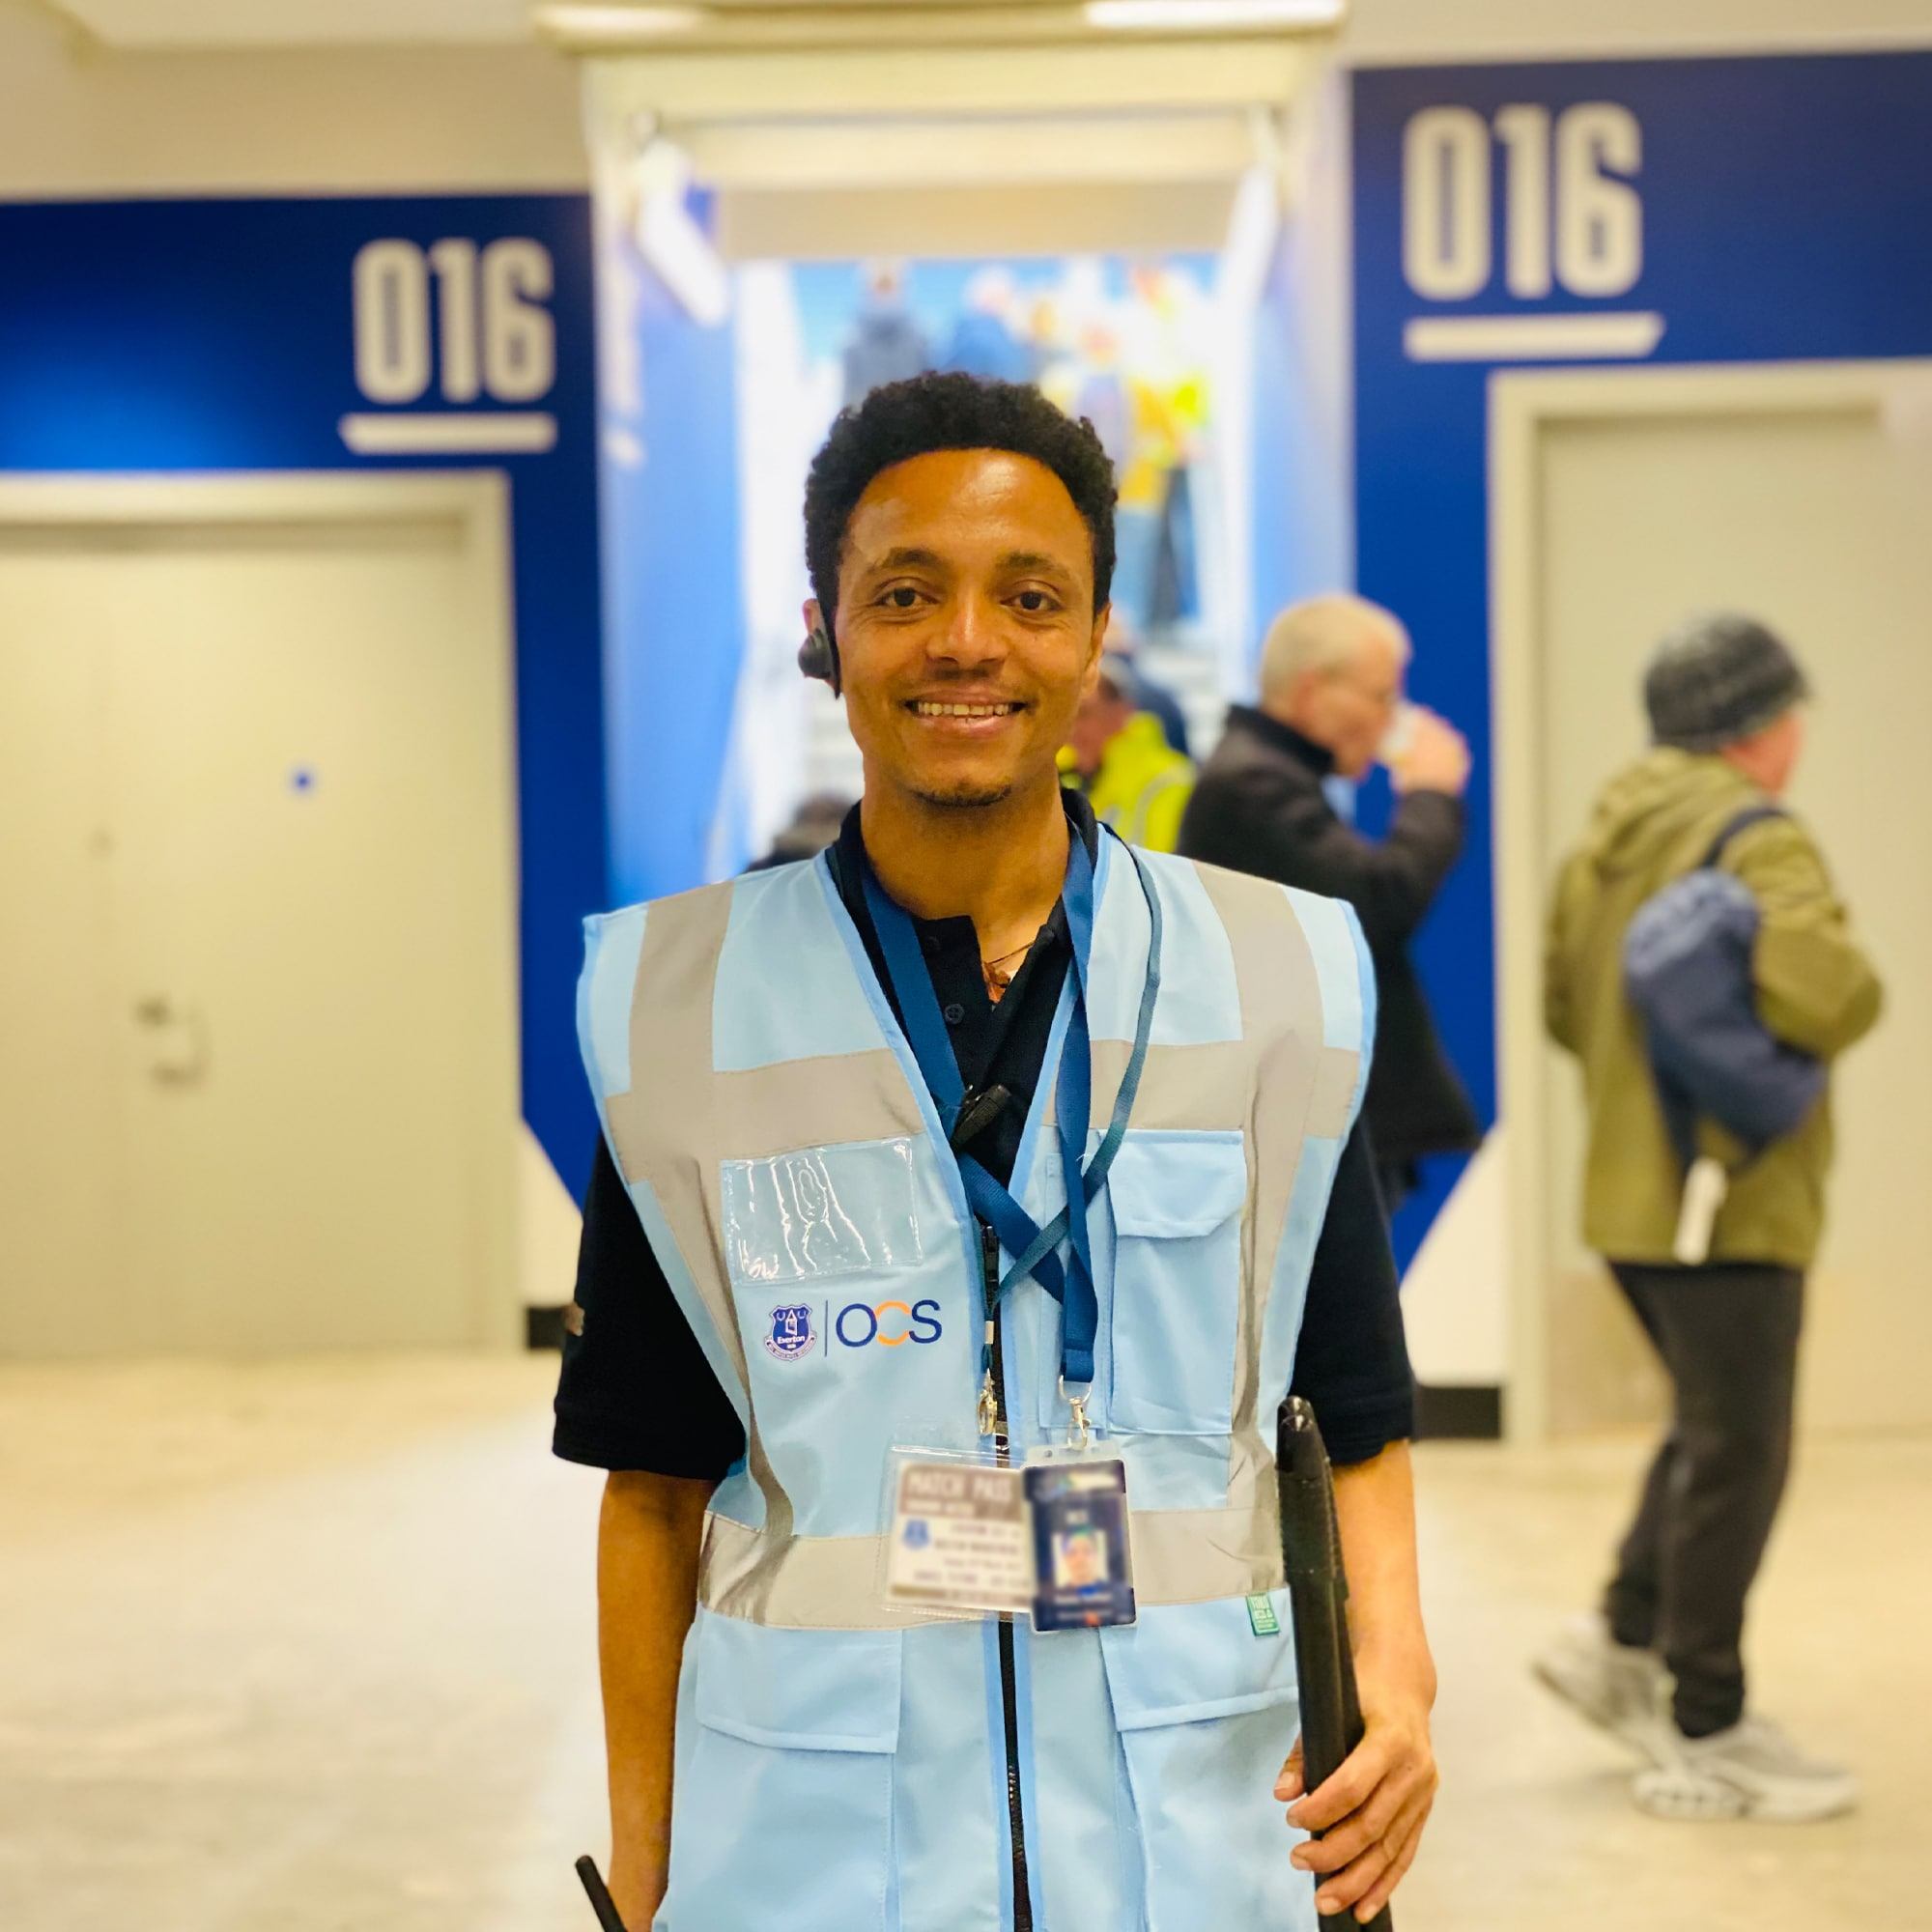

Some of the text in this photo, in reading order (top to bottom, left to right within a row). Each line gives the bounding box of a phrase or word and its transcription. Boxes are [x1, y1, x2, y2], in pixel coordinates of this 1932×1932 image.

[1404, 102, 1642, 299] 016
[353, 238, 555, 404] 016
[777, 1335, 806, 1344] Everton
[836, 1299, 942, 1348] OCS
